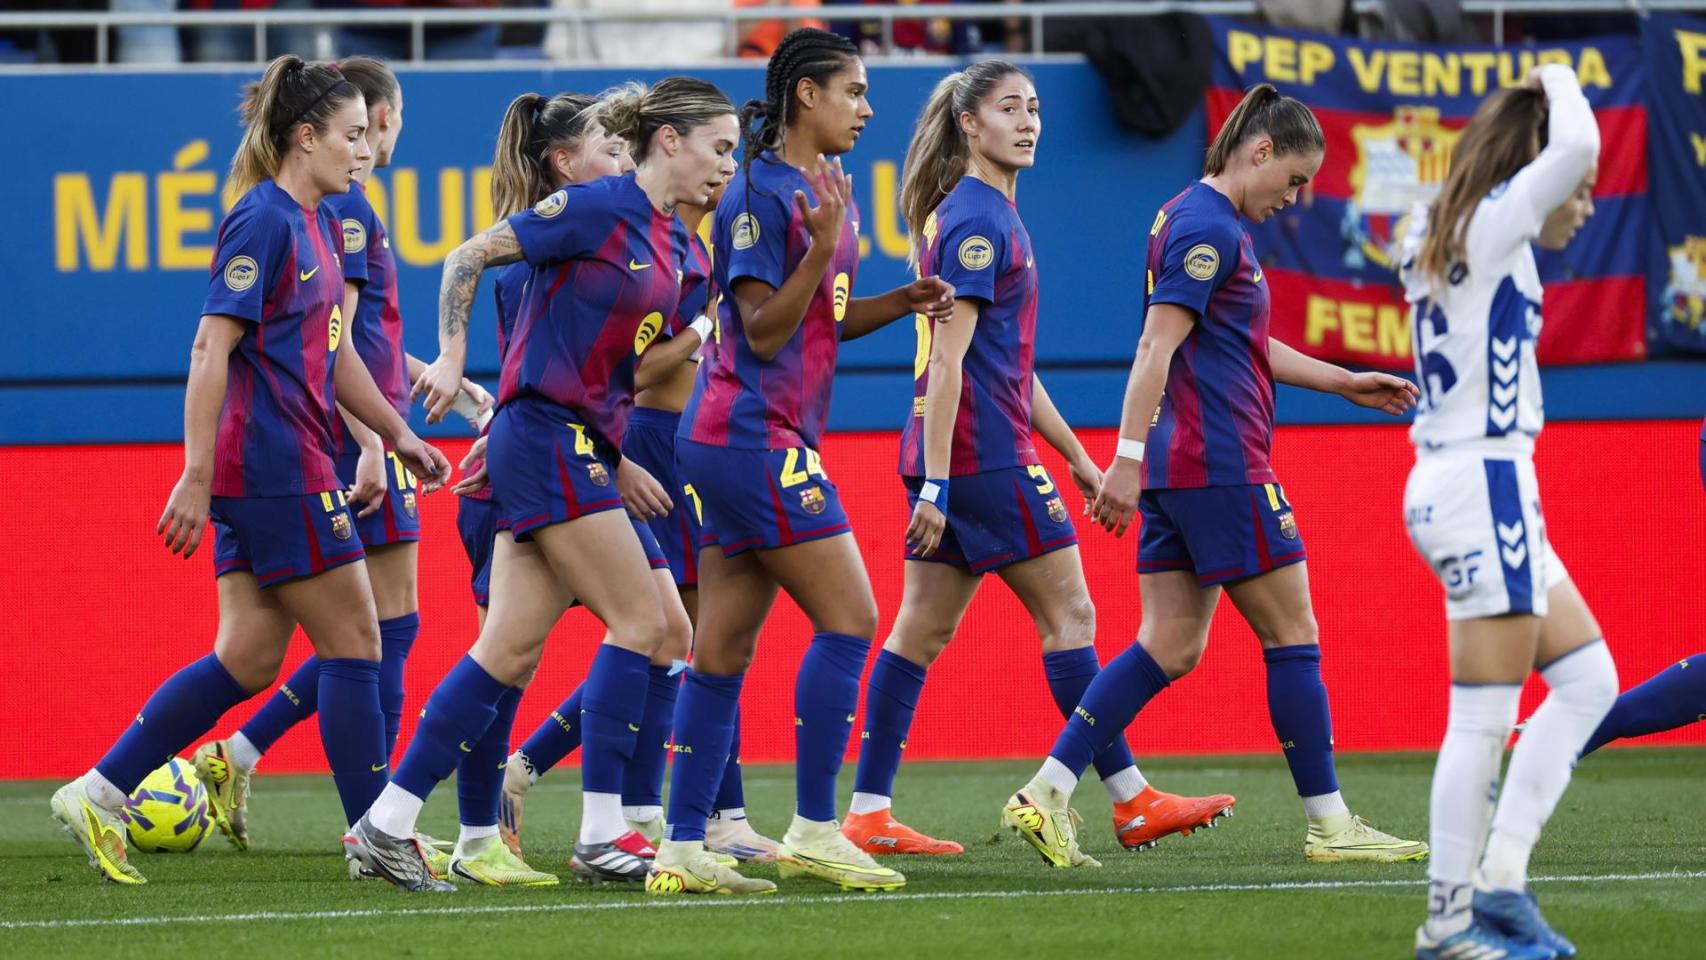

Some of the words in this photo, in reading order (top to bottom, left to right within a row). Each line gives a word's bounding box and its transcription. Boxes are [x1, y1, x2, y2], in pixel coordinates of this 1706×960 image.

[1227, 30, 1335, 85] PEP
[54, 139, 235, 272] MÉ
[780, 447, 828, 488] 24
